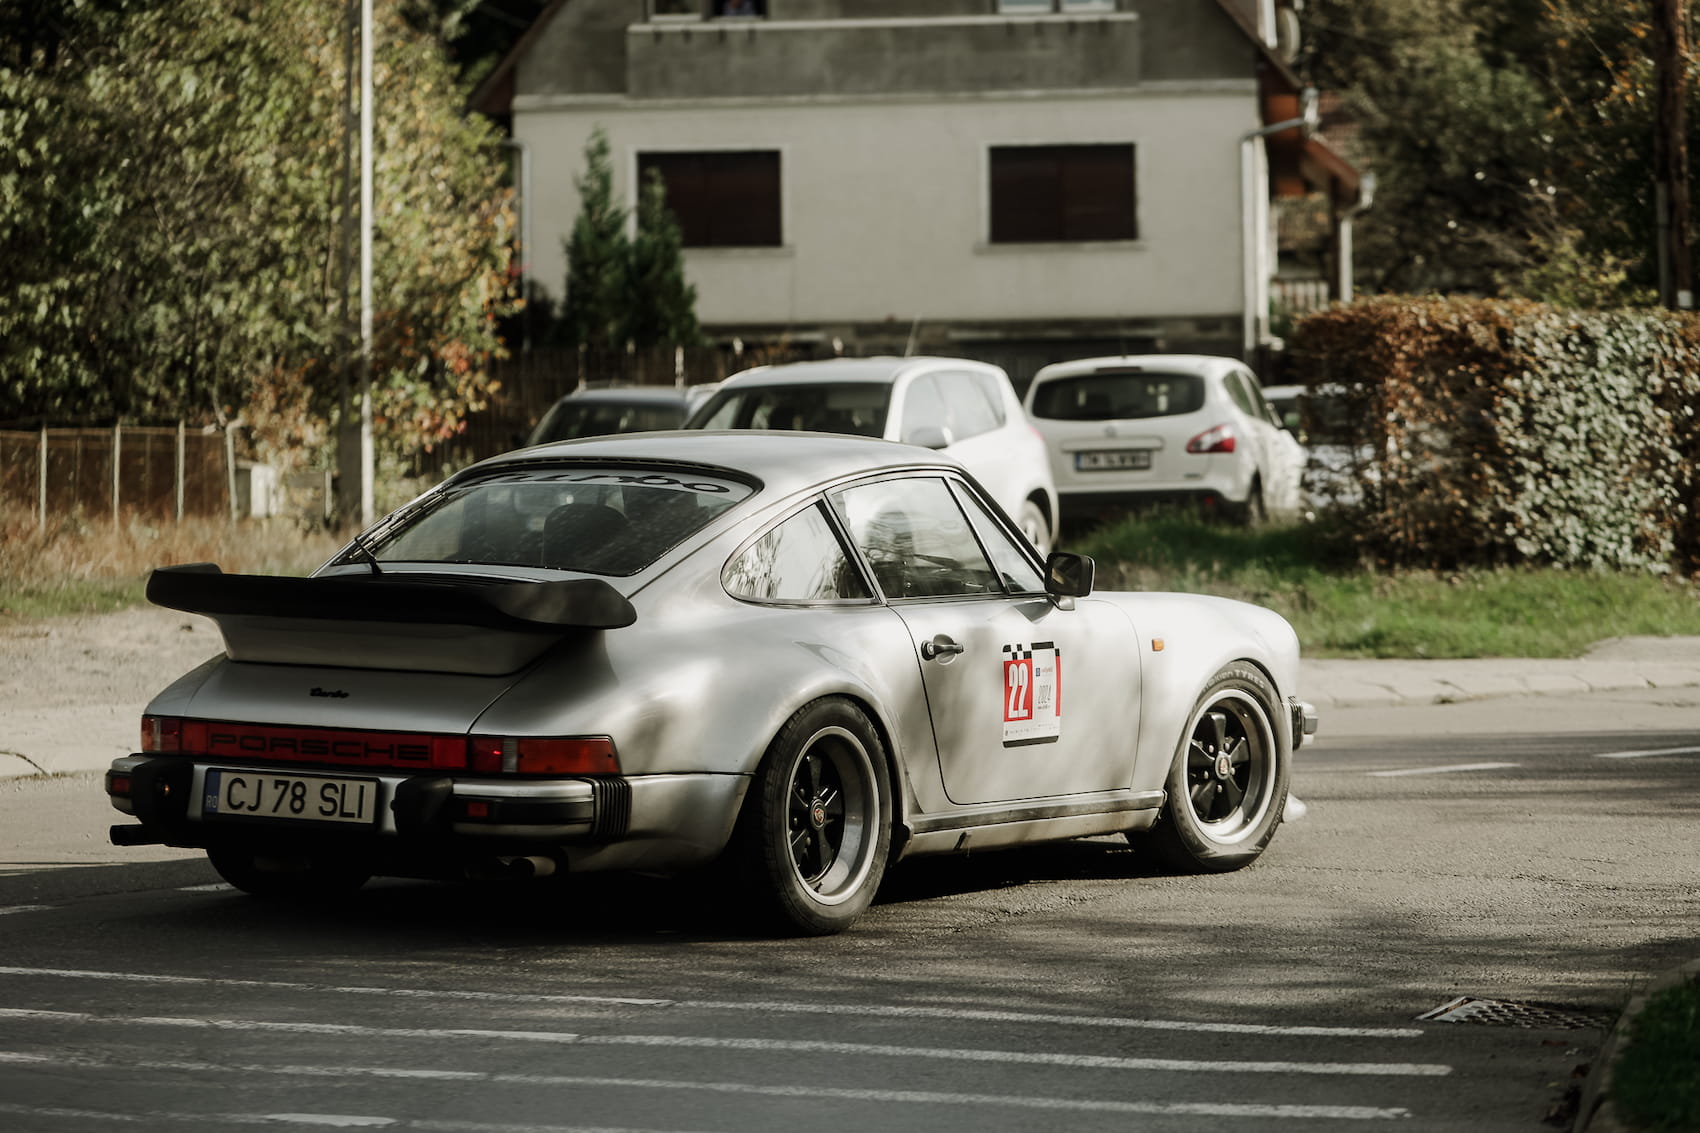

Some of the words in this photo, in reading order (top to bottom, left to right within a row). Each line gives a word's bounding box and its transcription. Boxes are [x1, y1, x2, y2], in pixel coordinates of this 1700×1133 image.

[1008, 663, 1029, 719] 22
[1234, 668, 1265, 690] TYRES
[211, 732, 430, 761] PORSCHE
[206, 794, 218, 809] RO
[227, 777, 264, 812] CJ
[271, 779, 308, 814] 78
[318, 782, 365, 819] SLI
